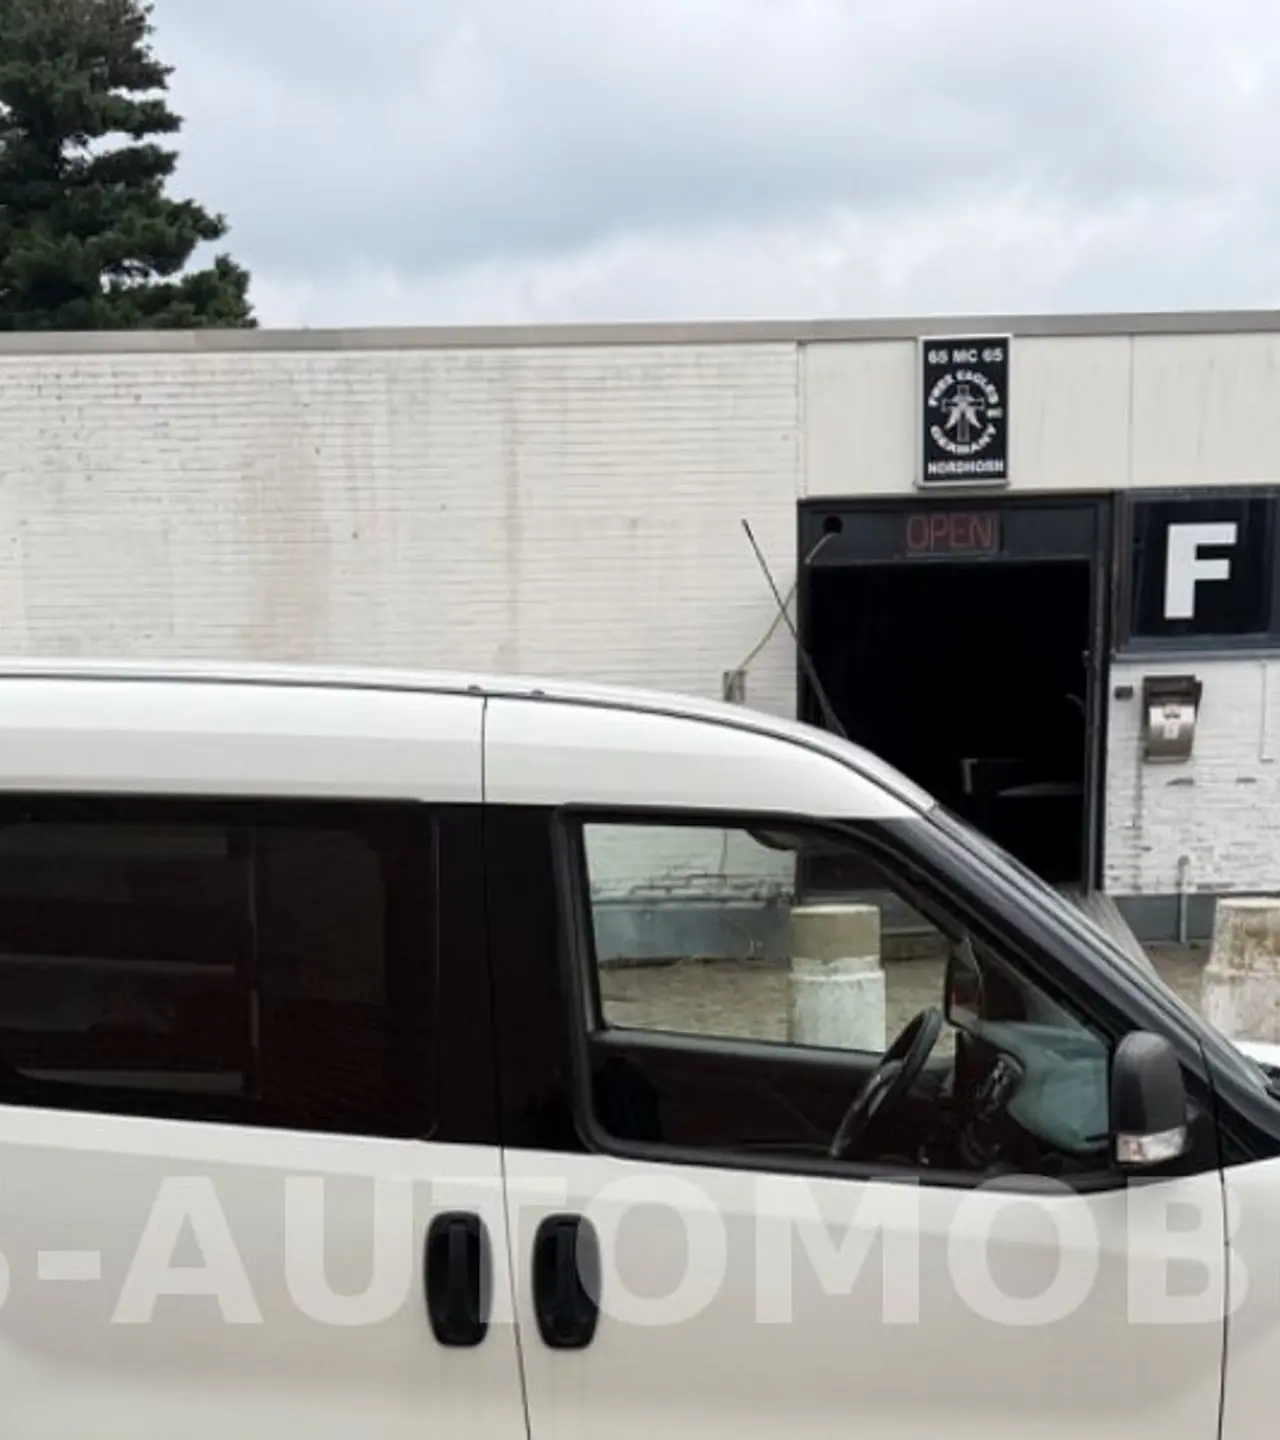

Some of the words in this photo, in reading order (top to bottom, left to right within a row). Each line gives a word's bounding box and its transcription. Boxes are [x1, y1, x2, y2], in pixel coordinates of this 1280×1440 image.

[951, 349, 979, 363] MC
[930, 422, 997, 455] GERMANY
[927, 459, 1004, 475] NORDHORN
[906, 511, 995, 551] OPEN
